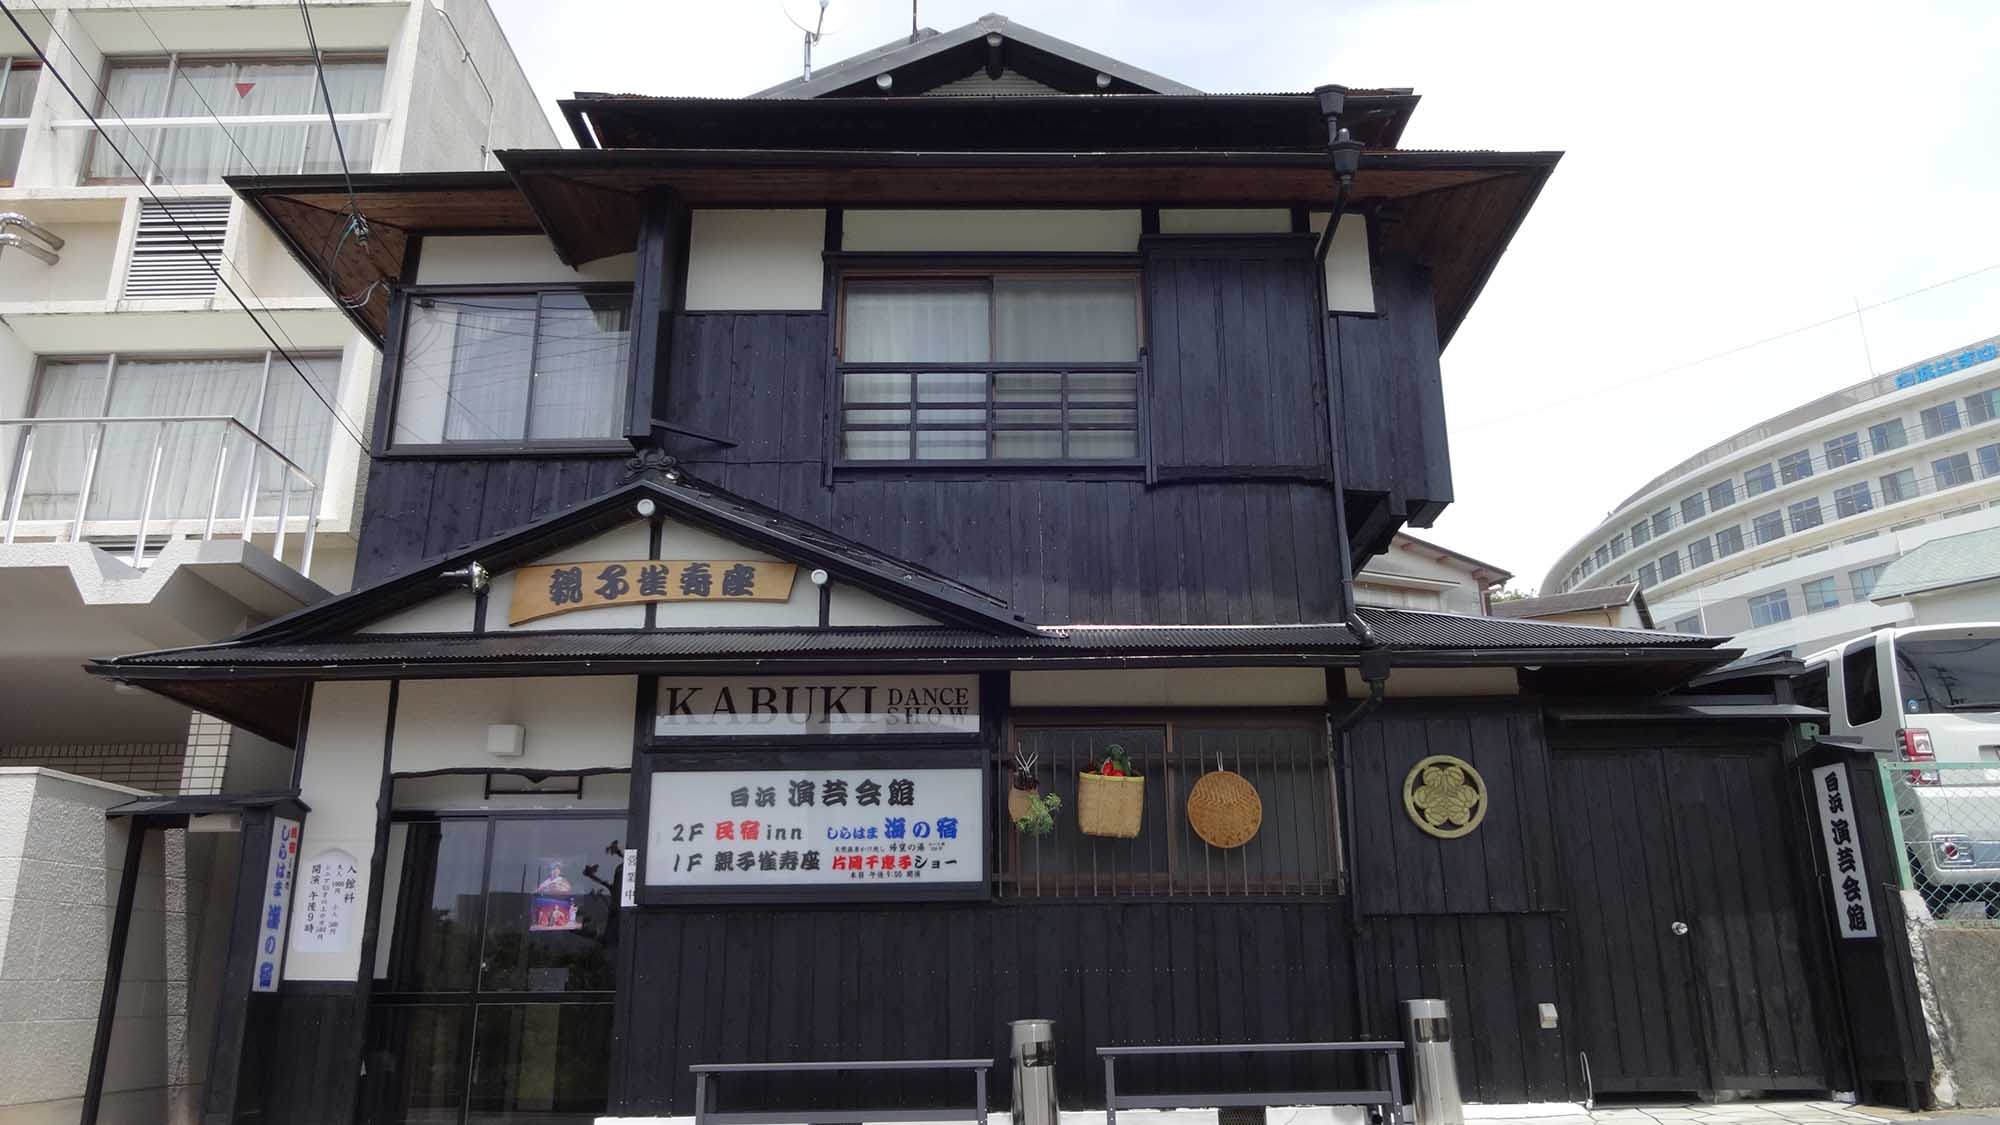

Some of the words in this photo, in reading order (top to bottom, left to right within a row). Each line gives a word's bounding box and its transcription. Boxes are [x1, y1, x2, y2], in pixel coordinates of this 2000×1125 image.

[664, 685, 878, 726] KABUKI
[887, 687, 969, 706] DANCE
[886, 706, 969, 726] SHOW
[672, 823, 704, 842] 2F
